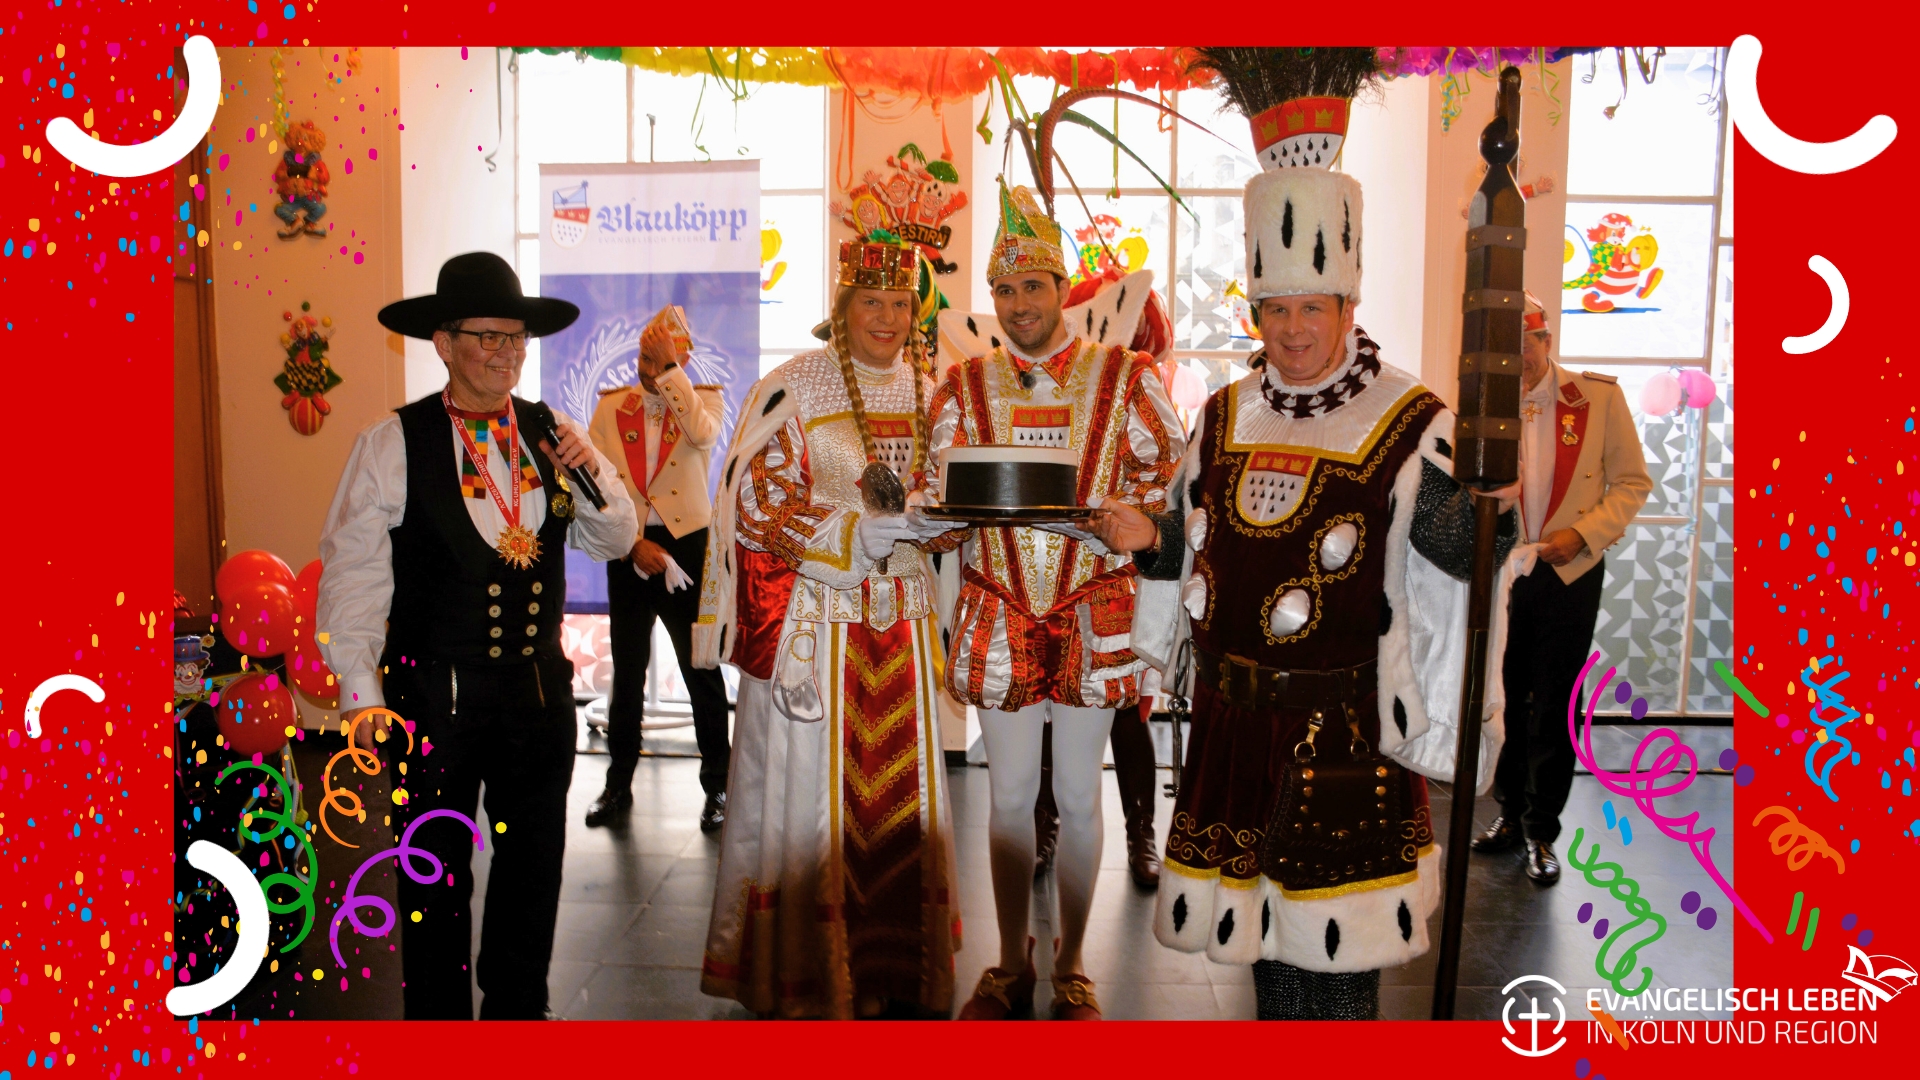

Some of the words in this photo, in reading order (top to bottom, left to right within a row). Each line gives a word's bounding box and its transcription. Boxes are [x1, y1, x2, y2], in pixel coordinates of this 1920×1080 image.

[596, 200, 747, 242] Blauköpp
[598, 235, 667, 244] EVANGELISCH
[671, 234, 706, 243] FEIERN
[477, 461, 488, 475] UHU
[490, 486, 500, 501] 1924
